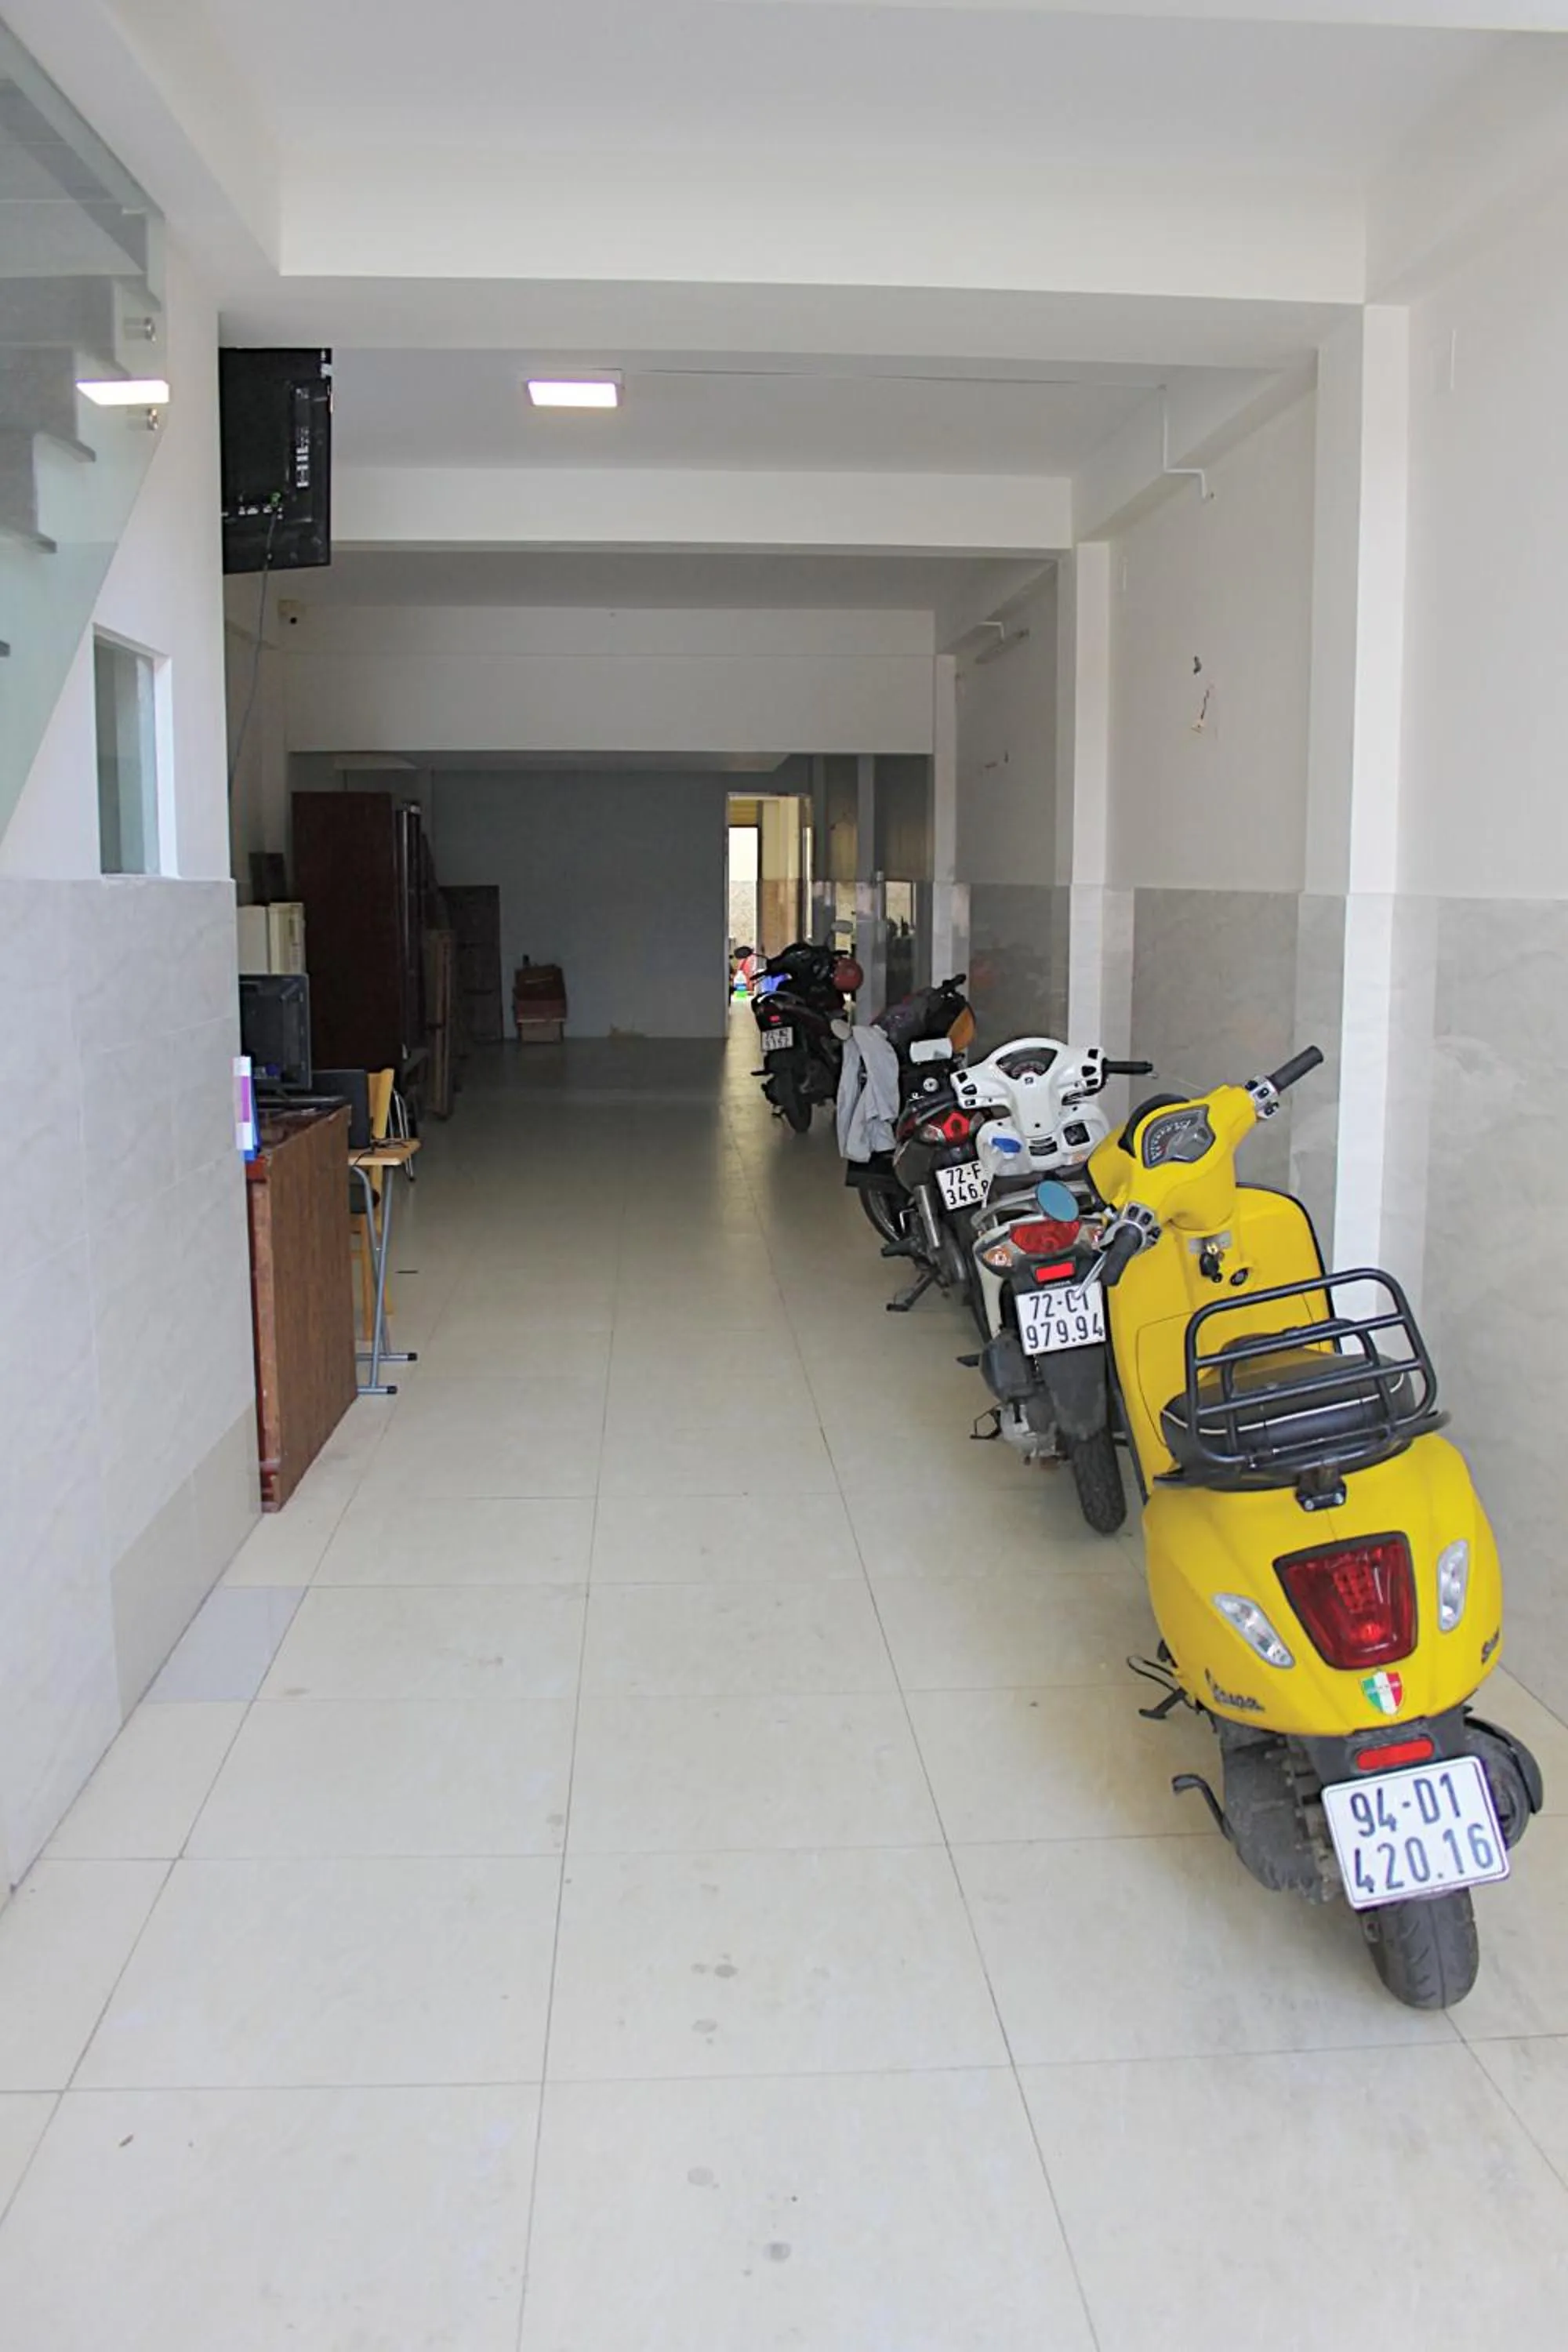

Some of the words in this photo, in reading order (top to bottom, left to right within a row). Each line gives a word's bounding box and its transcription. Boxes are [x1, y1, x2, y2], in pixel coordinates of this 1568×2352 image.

[946, 1163, 982, 1186] 72-F
[1029, 1289, 1089, 1320] 72-C1
[1025, 1312, 1103, 1349] 979.94
[1349, 1772, 1461, 1838] 94-D1
[1354, 1822, 1494, 1894] 420.16
